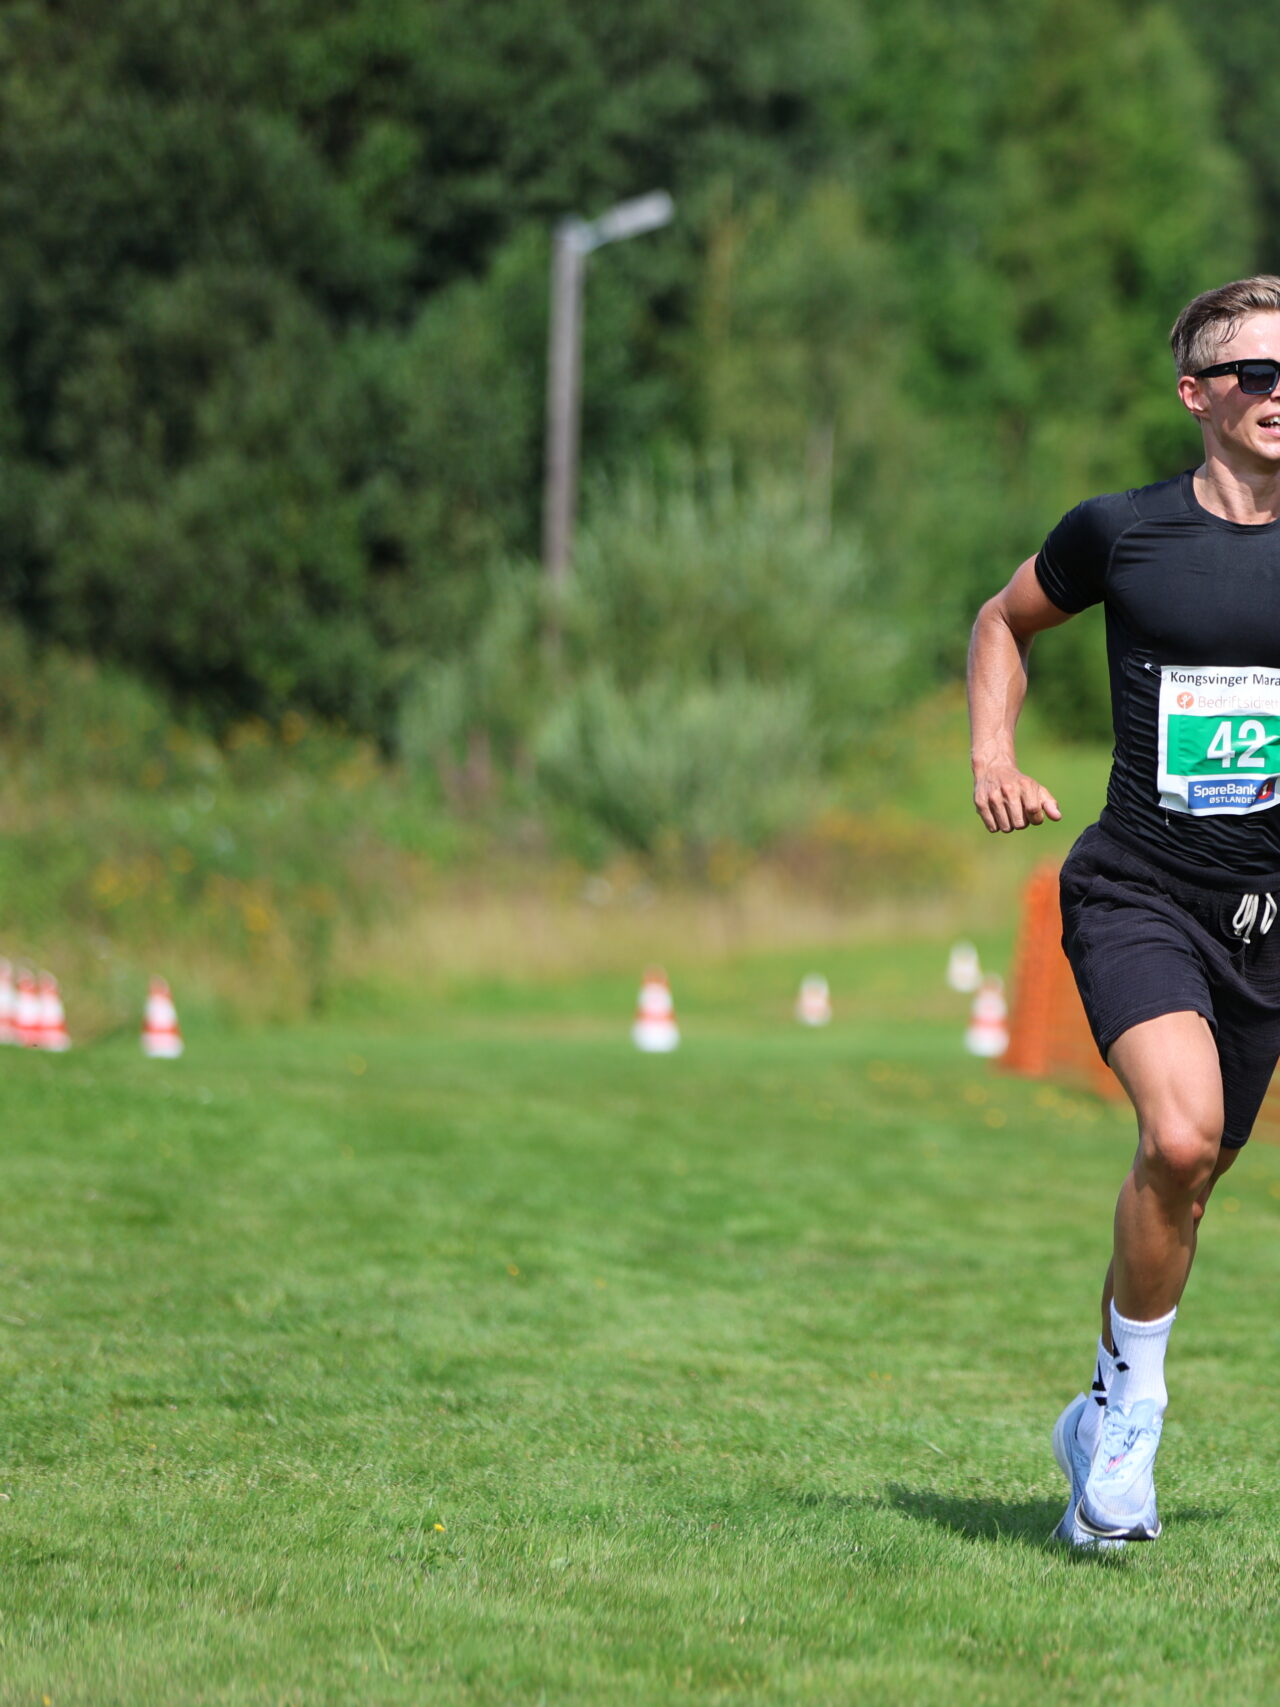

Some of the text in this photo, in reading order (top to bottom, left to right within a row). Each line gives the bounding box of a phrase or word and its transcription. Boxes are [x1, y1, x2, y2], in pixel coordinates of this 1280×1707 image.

[1170, 671, 1248, 687] Kongsvinger
[1207, 720, 1266, 768] 42
[1193, 783, 1257, 798] SpareBank
[1209, 796, 1256, 804] ØSTLANDET
